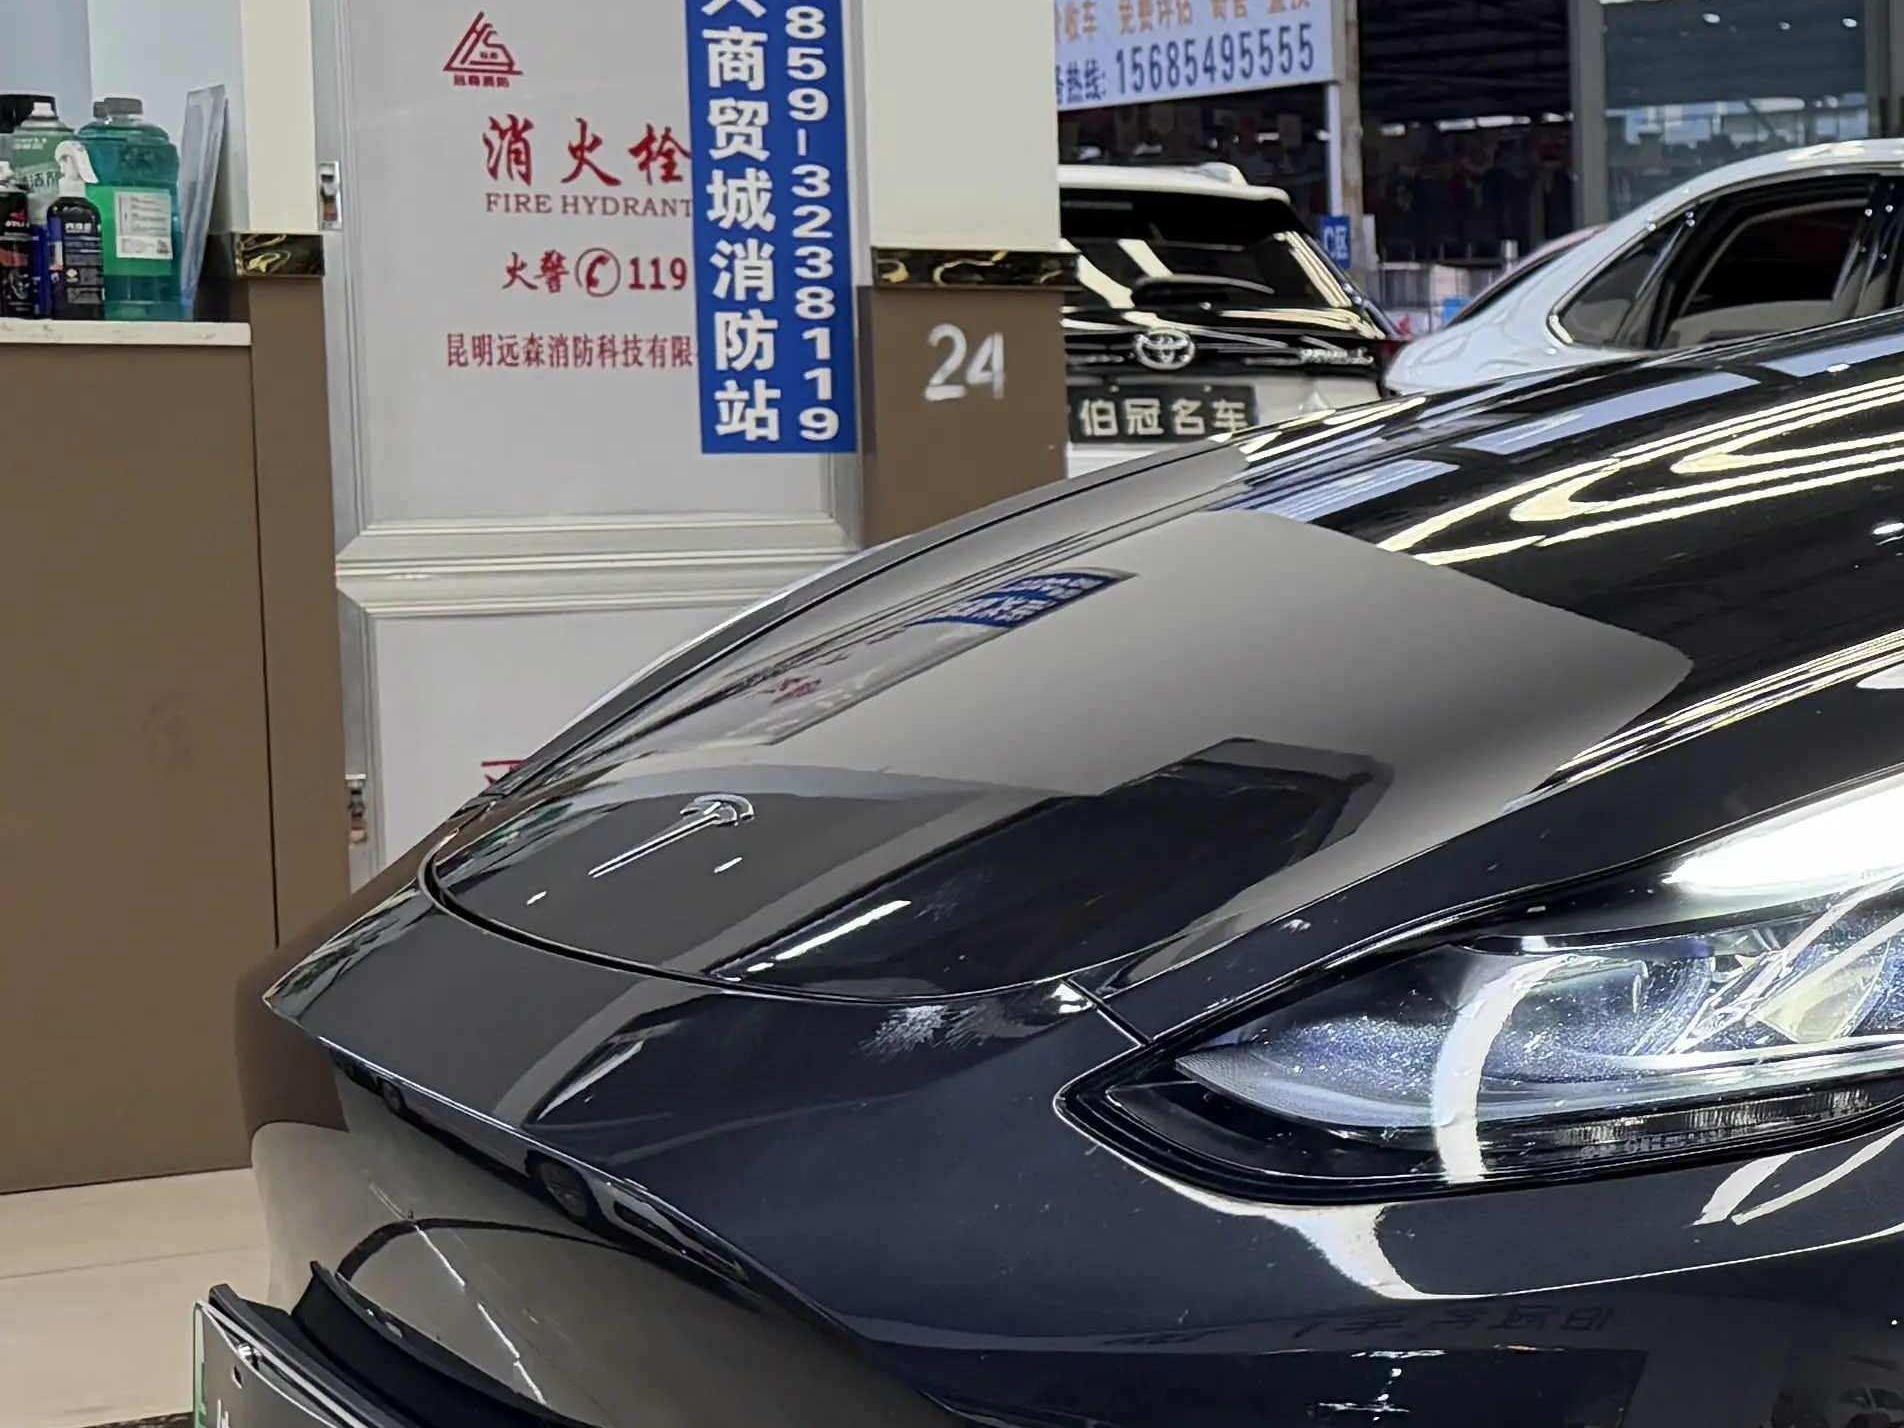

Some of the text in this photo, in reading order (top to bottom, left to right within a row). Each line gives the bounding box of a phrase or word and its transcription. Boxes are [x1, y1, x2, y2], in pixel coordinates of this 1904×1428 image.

[1115, 22, 1315, 96] 15685495555
[482, 113, 692, 186] 消火栓
[485, 192, 693, 218] FIRE HYDRANT
[502, 249, 688, 294] 火警 119
[923, 323, 1006, 402] 24
[1080, 397, 1248, 436] 伯冠名车
